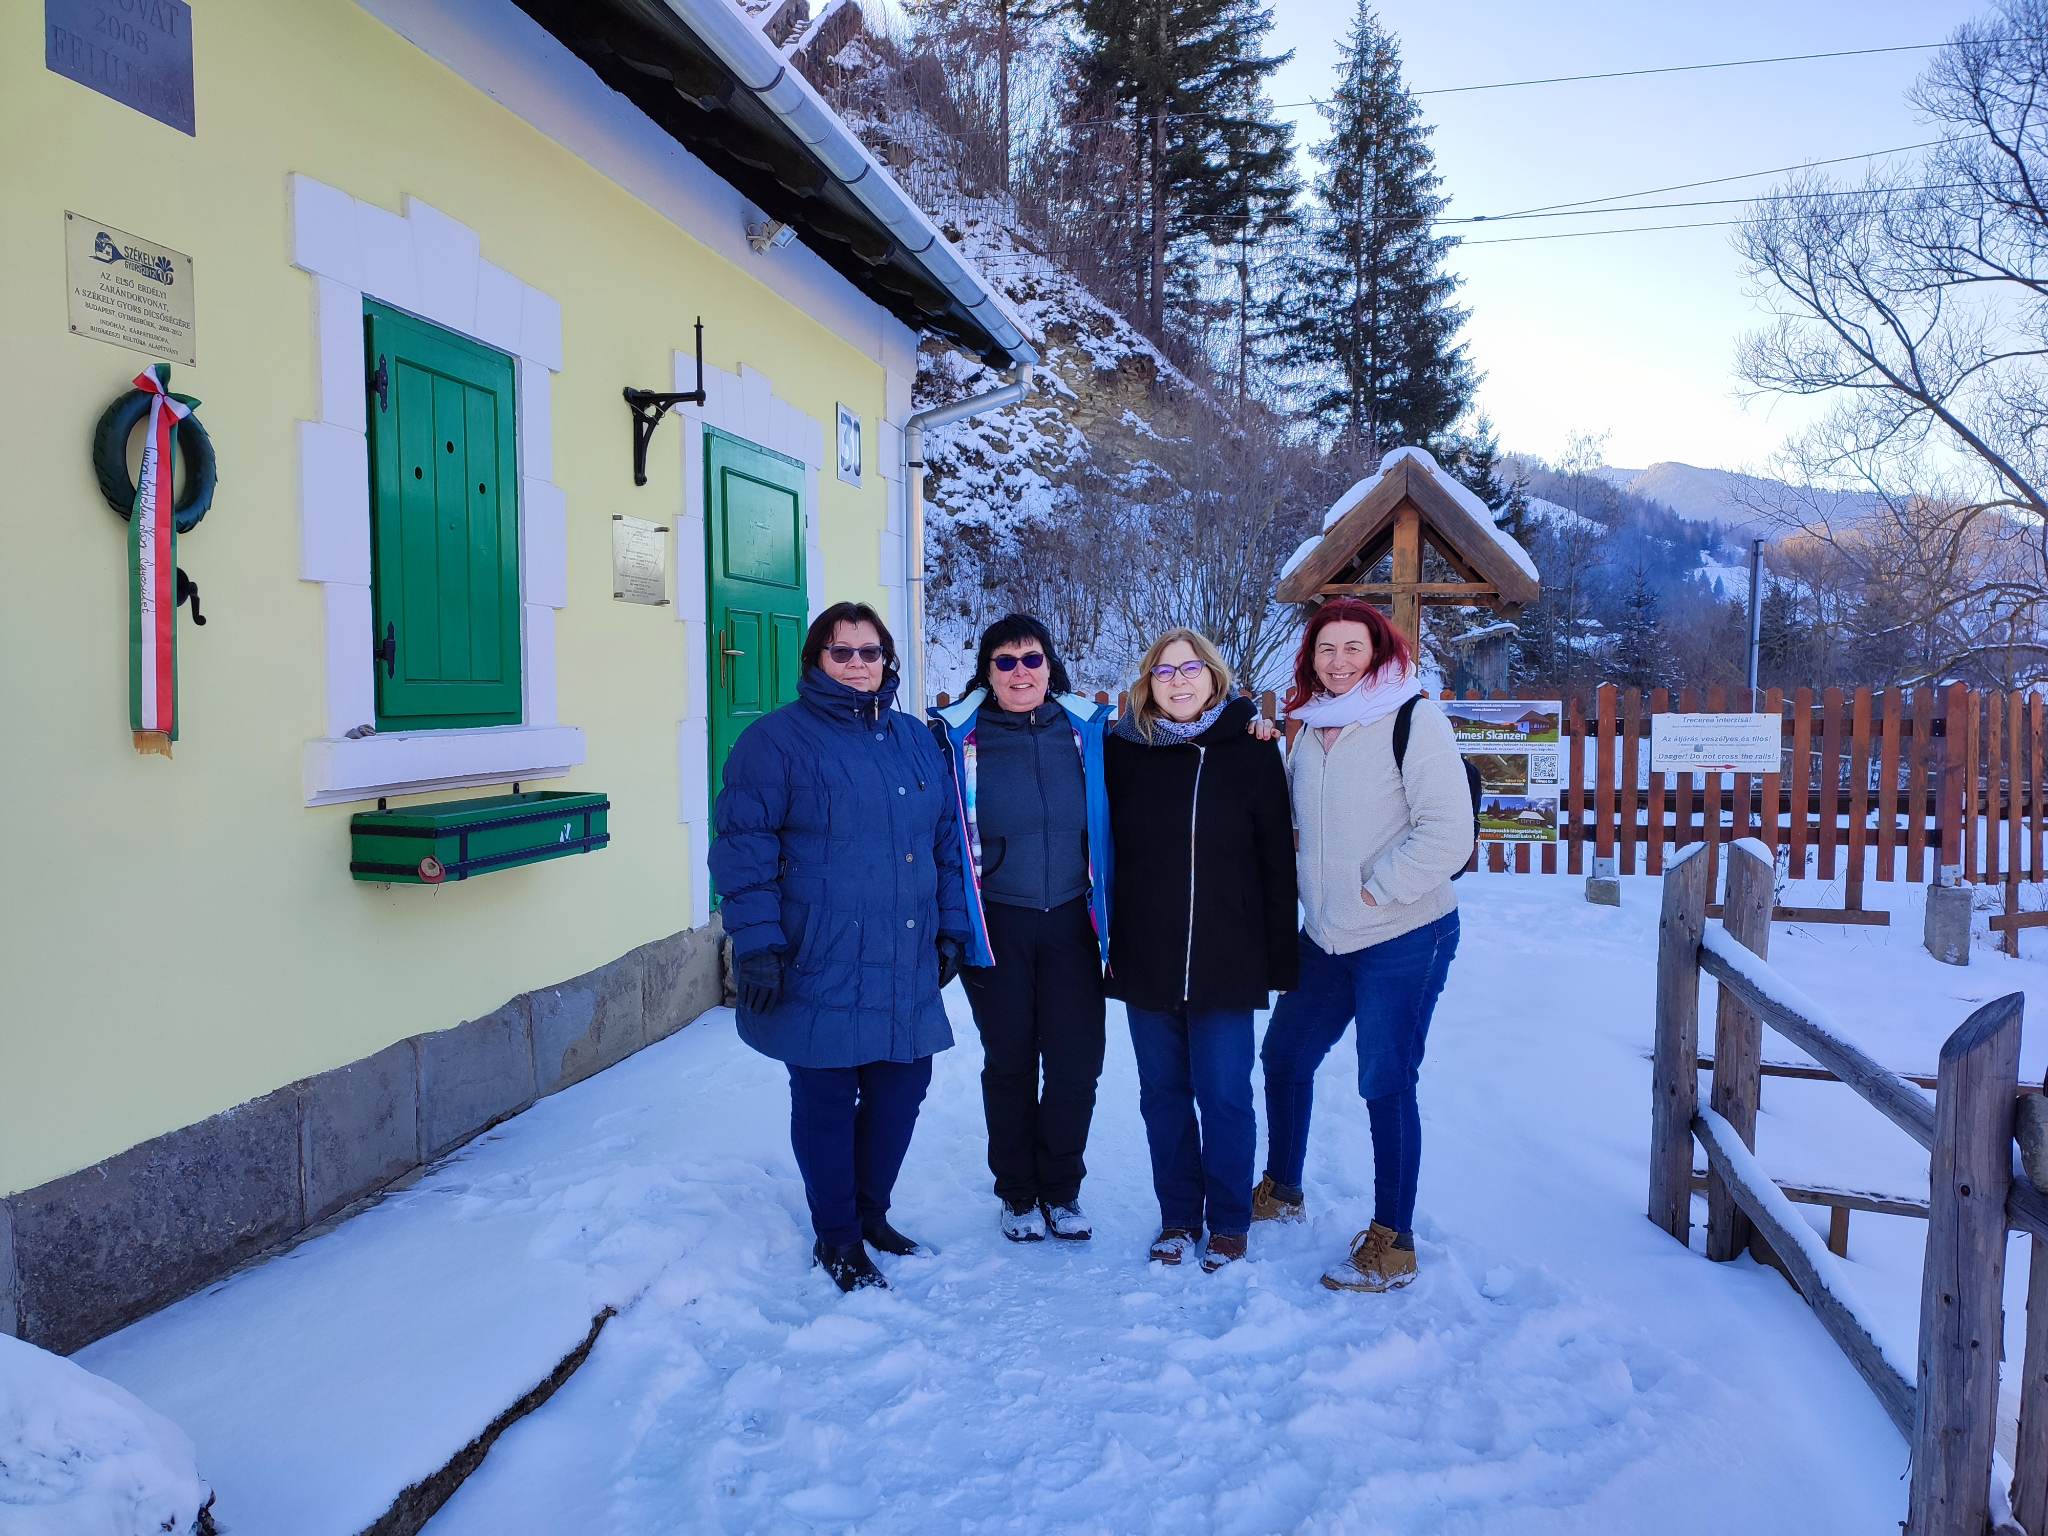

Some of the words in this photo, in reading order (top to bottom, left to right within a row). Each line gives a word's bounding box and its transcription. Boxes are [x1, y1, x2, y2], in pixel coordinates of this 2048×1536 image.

[94, 7, 149, 55] 2008
[124, 244, 157, 269] SZÉKELY
[100, 271, 112, 281] AZ
[115, 275, 135, 289] ELSŐ
[137, 284, 168, 299] ERDÉLYI
[74, 287, 81, 296] A
[82, 289, 115, 306] SZÉKELY
[116, 300, 142, 314] GYORS
[143, 308, 192, 330] DICSŐSÉGÉRE
[1486, 730, 1528, 741] Skanzen
[1701, 735, 1739, 743] veszélyes
